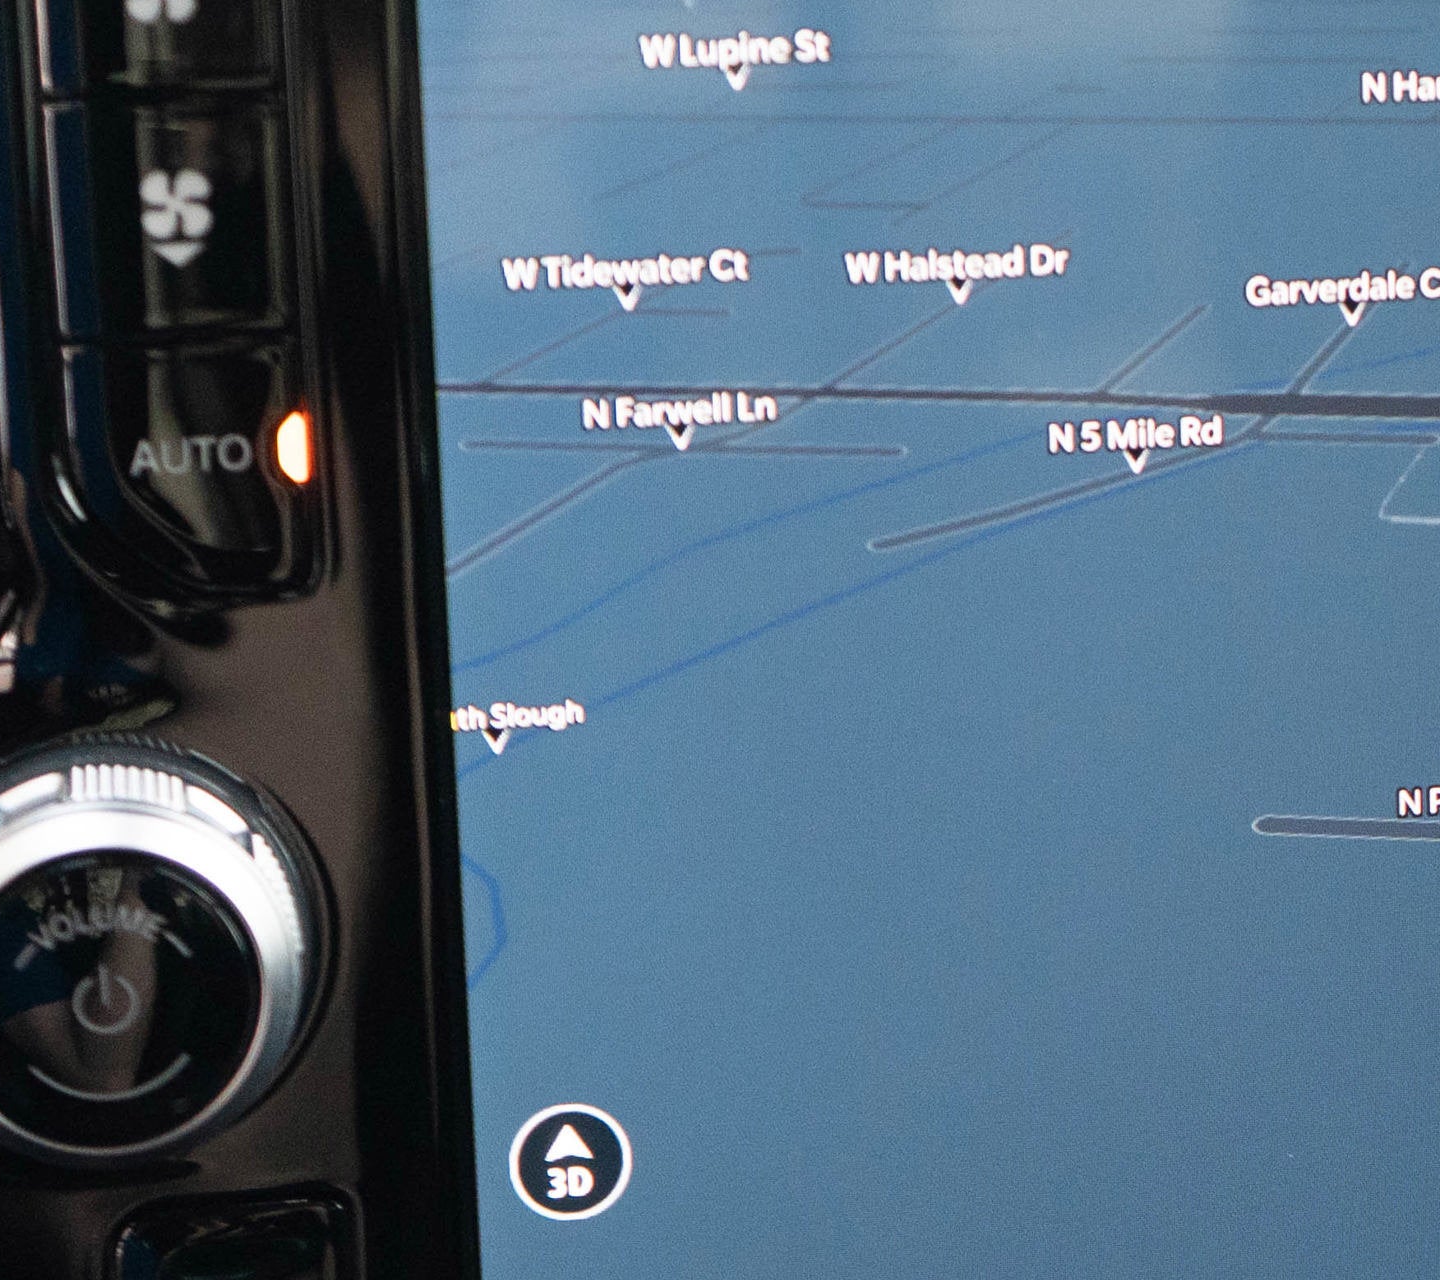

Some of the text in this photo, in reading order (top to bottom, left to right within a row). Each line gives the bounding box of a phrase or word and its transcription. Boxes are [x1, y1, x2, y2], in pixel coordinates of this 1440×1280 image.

[639, 28, 830, 71] W Lupine St
[1361, 72, 1387, 101] N
[502, 248, 750, 291] W Tidewater Ct
[845, 244, 1070, 285] W Halstead Dr
[1245, 272, 1413, 309] Garverdale
[582, 390, 777, 432] N Farwell Ln
[1048, 413, 1224, 454] N 5 Mile Rd
[130, 433, 252, 478] AUTO
[489, 698, 585, 731] Slough
[1398, 787, 1422, 818] N
[546, 1166, 594, 1200] 3D
